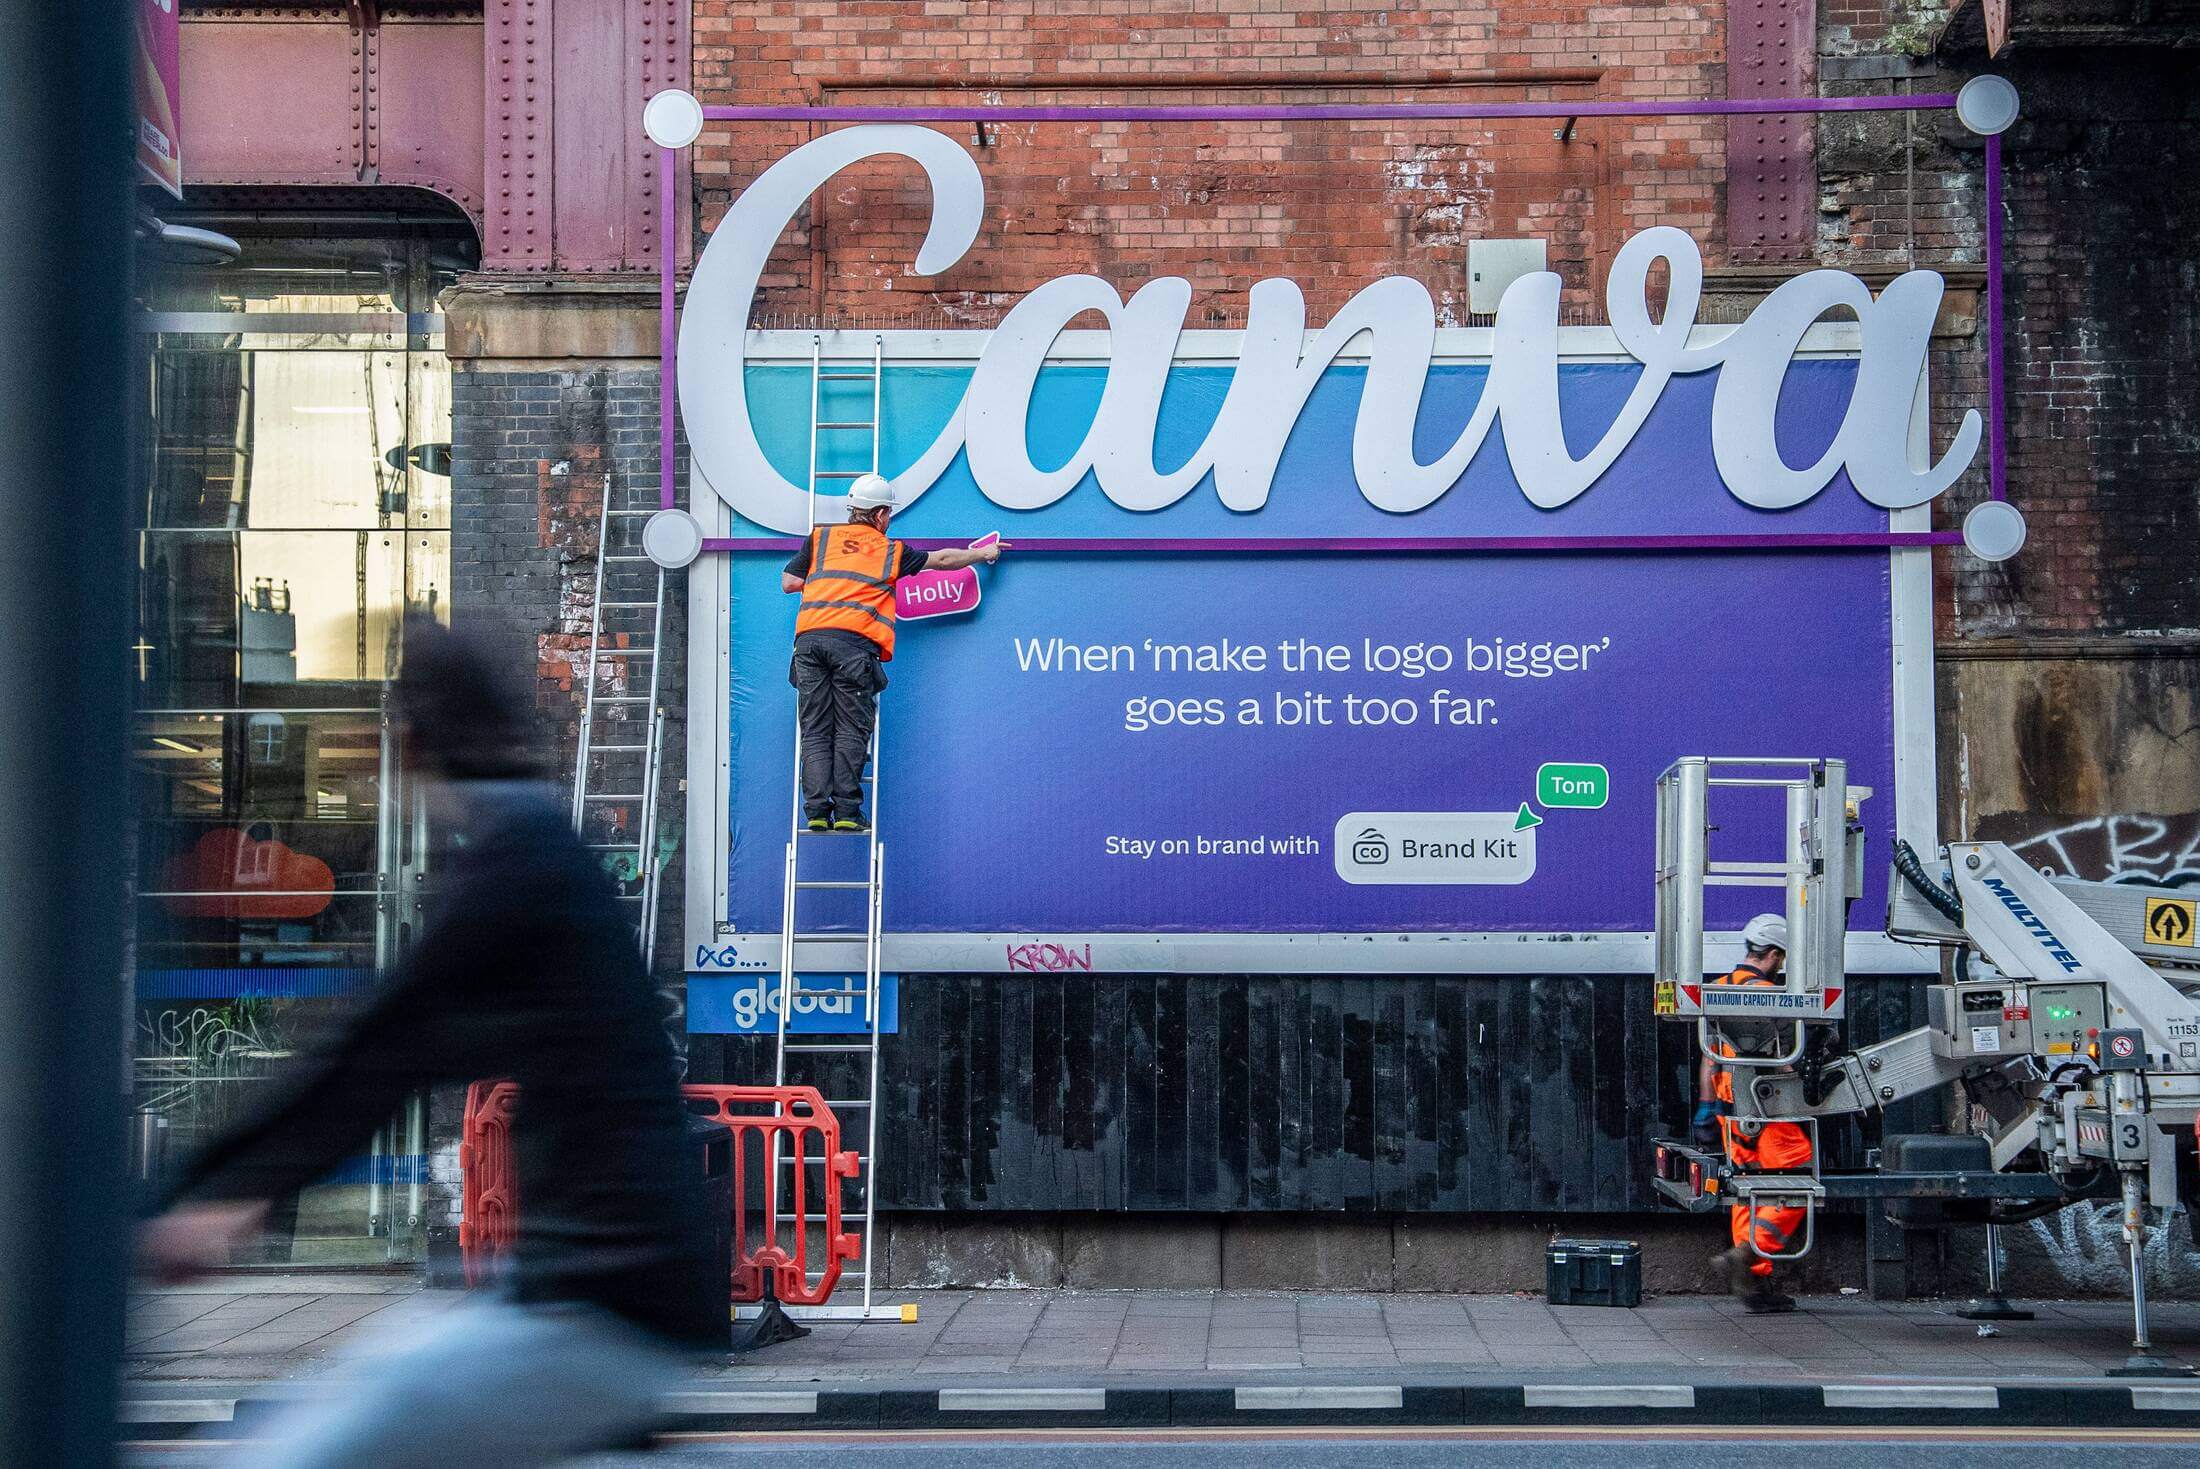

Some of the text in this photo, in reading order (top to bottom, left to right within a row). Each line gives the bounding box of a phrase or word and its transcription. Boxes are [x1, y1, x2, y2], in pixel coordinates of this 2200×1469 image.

[678, 124, 1981, 535] Canva
[904, 580, 964, 605] Holly
[1014, 636, 1610, 678] When ‘make the logo bigger’
[1124, 689, 1499, 732] goes a bit too far.
[1551, 776, 1596, 795] Tom
[1105, 835, 1320, 859] Stay on brand with
[1402, 838, 1518, 858] Brand Kit
[1982, 878, 2083, 974] MULTITEL
[732, 977, 853, 1029] global
[1706, 993, 1742, 1007] MAXIMUM
[1743, 994, 1777, 1008] CAPACITY
[1778, 995, 1793, 1008] 225
[1794, 996, 1804, 1009] KG
[2167, 1024, 2199, 1036] 11153
[2122, 1124, 2141, 1149] 3
